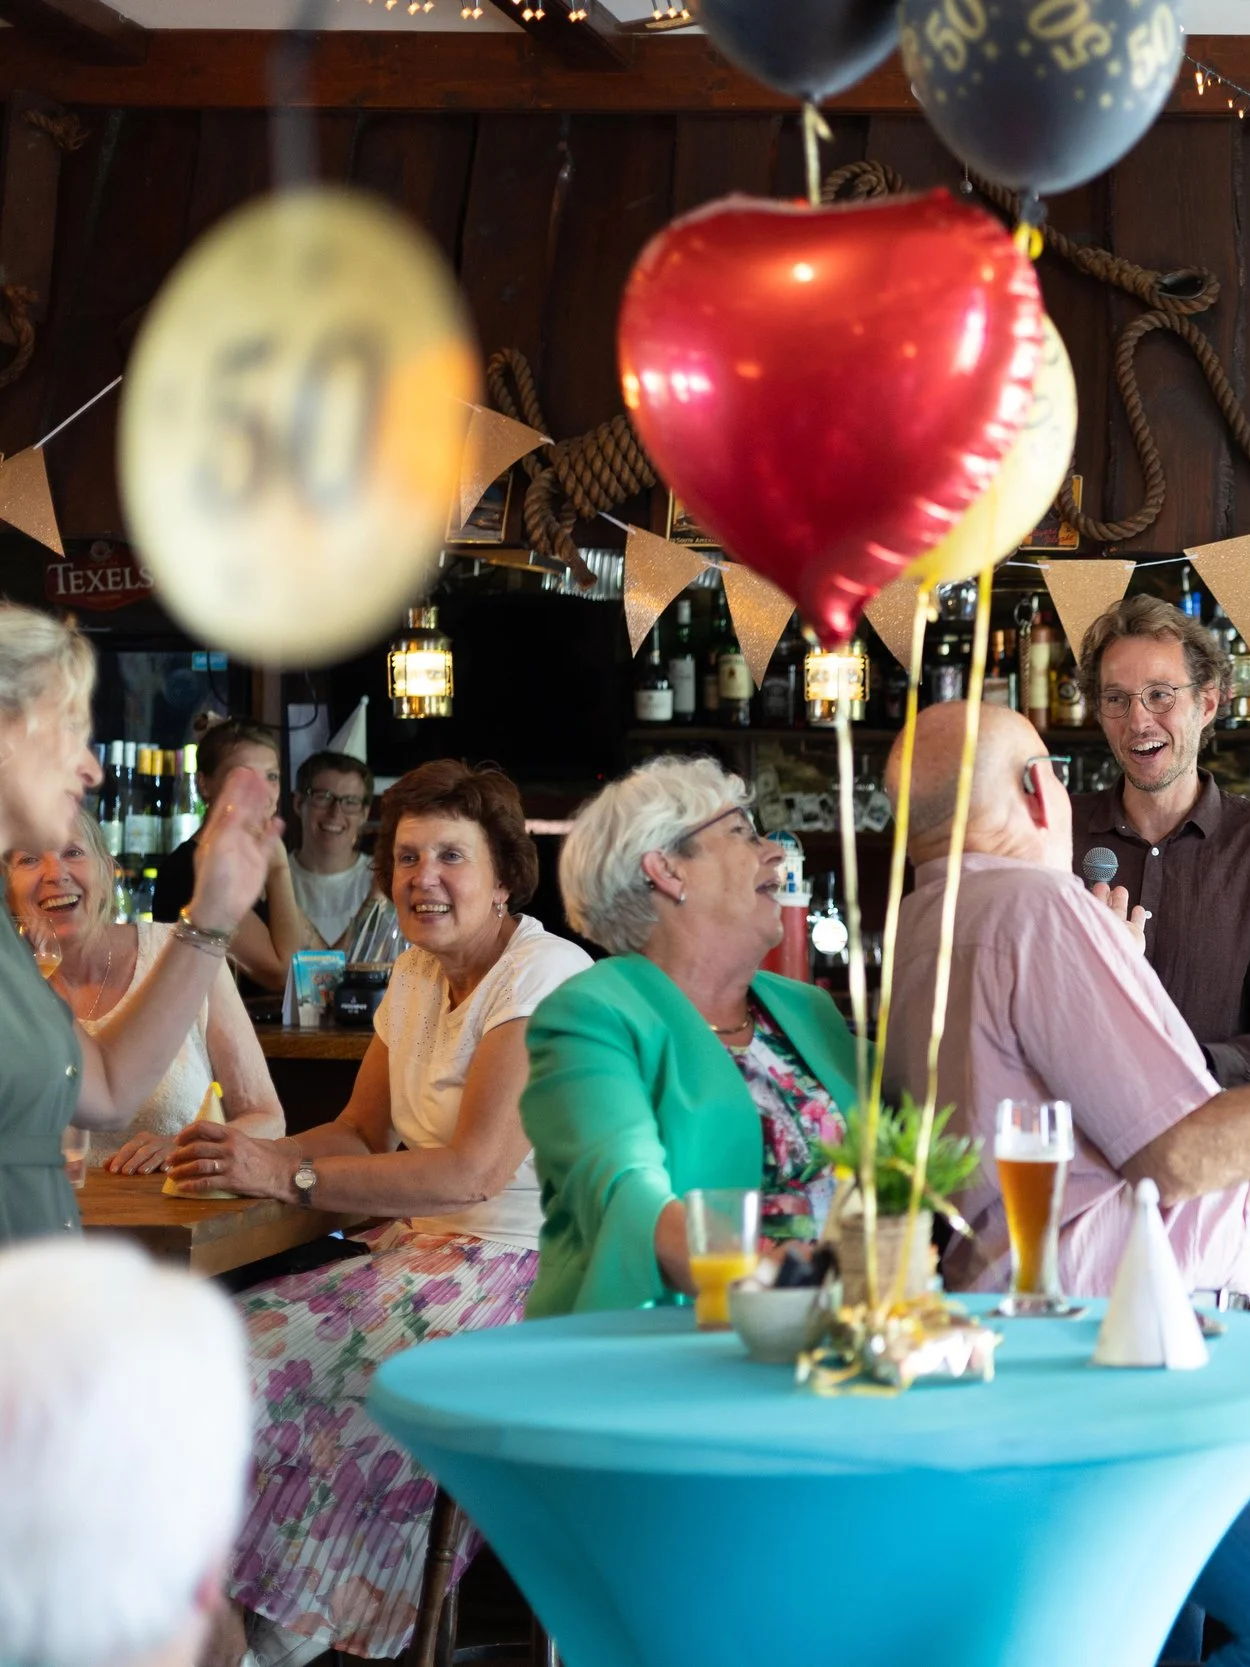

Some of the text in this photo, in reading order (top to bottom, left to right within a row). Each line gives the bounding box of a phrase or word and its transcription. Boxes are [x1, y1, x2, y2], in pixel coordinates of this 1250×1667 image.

[925, 0, 987, 73] 50
[1027, 0, 1112, 72] 50
[1127, 3, 1175, 90] 50
[191, 328, 388, 515] 50
[47, 562, 155, 596] TEXELS
